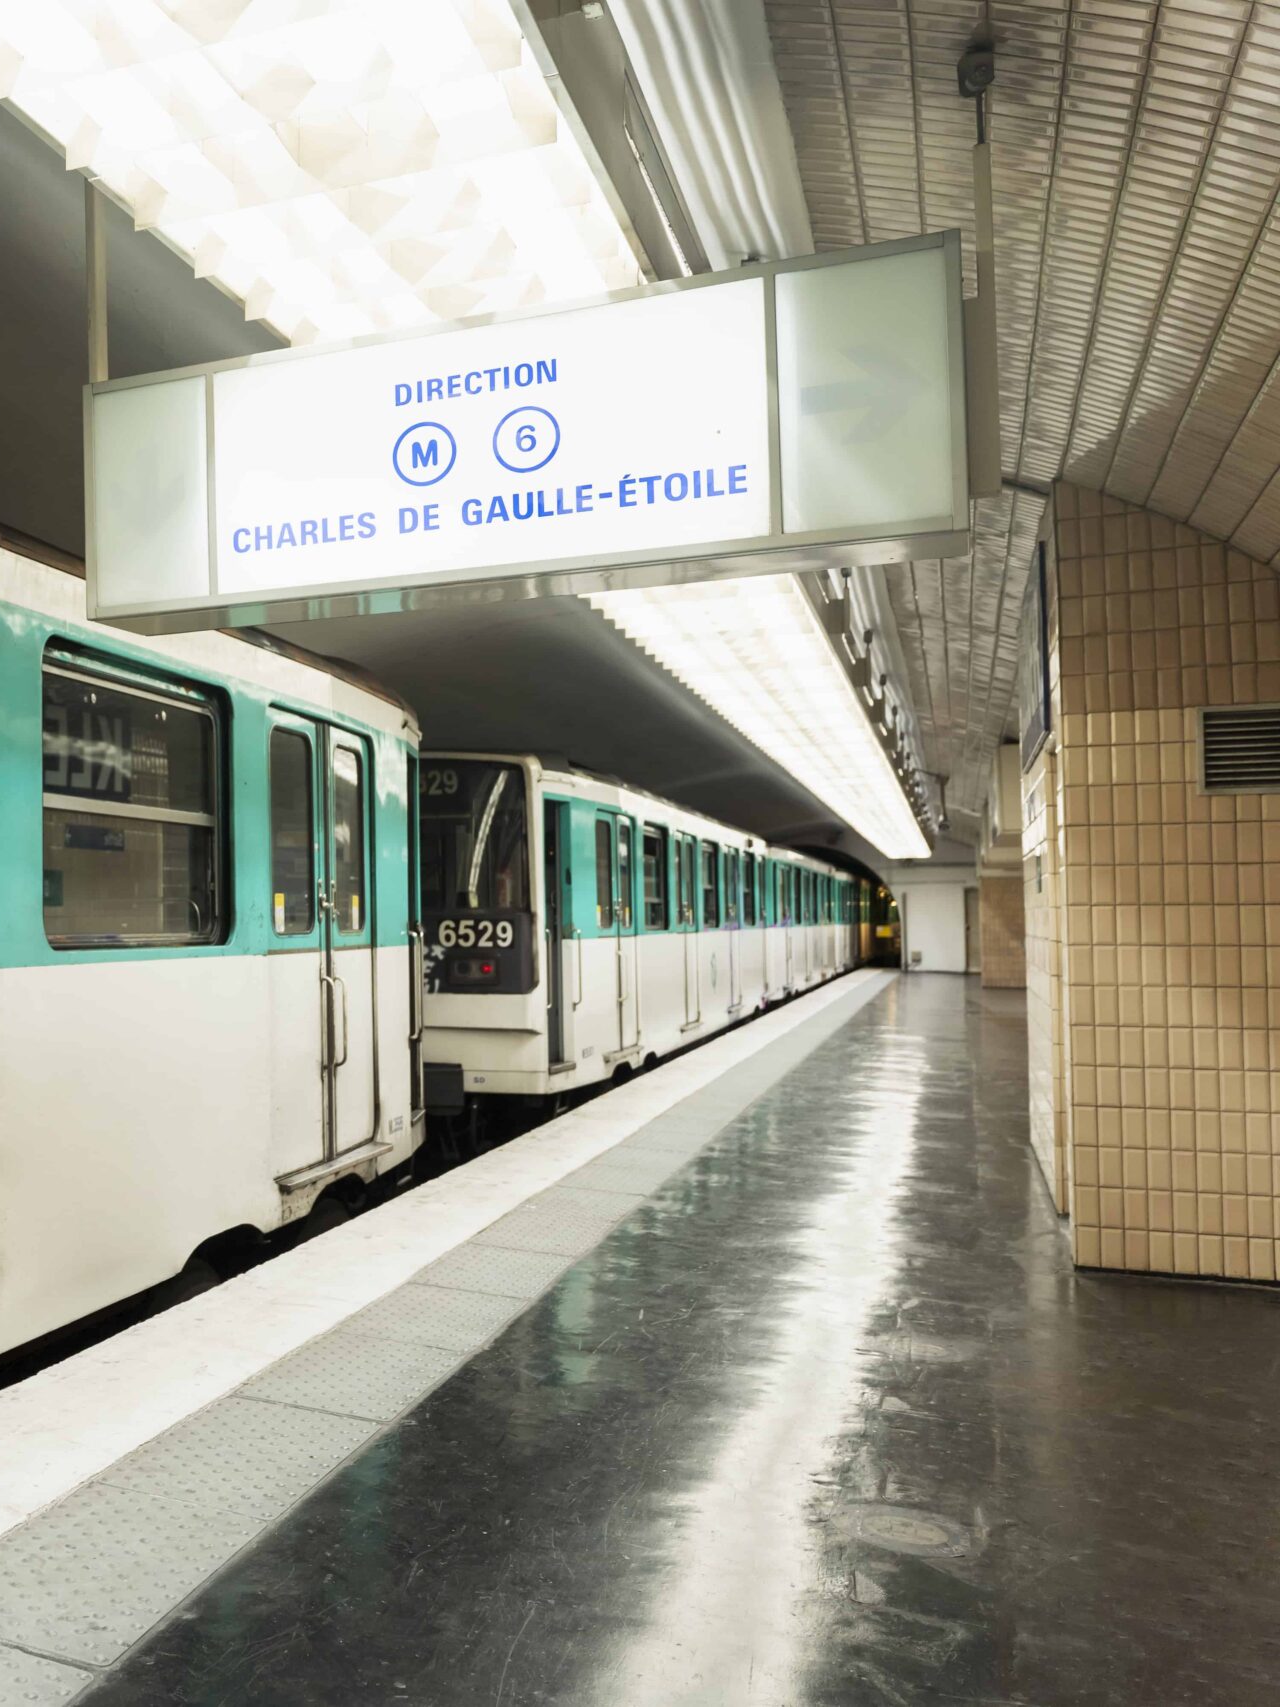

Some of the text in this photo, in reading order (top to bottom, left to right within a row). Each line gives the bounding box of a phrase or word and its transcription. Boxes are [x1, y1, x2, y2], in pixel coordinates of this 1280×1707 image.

[395, 358, 558, 407] DIRECTION
[411, 424, 537, 469] M 6
[232, 464, 749, 554] CHARLES DE GAULLE-ÉTOILE
[438, 919, 514, 948] 6529
